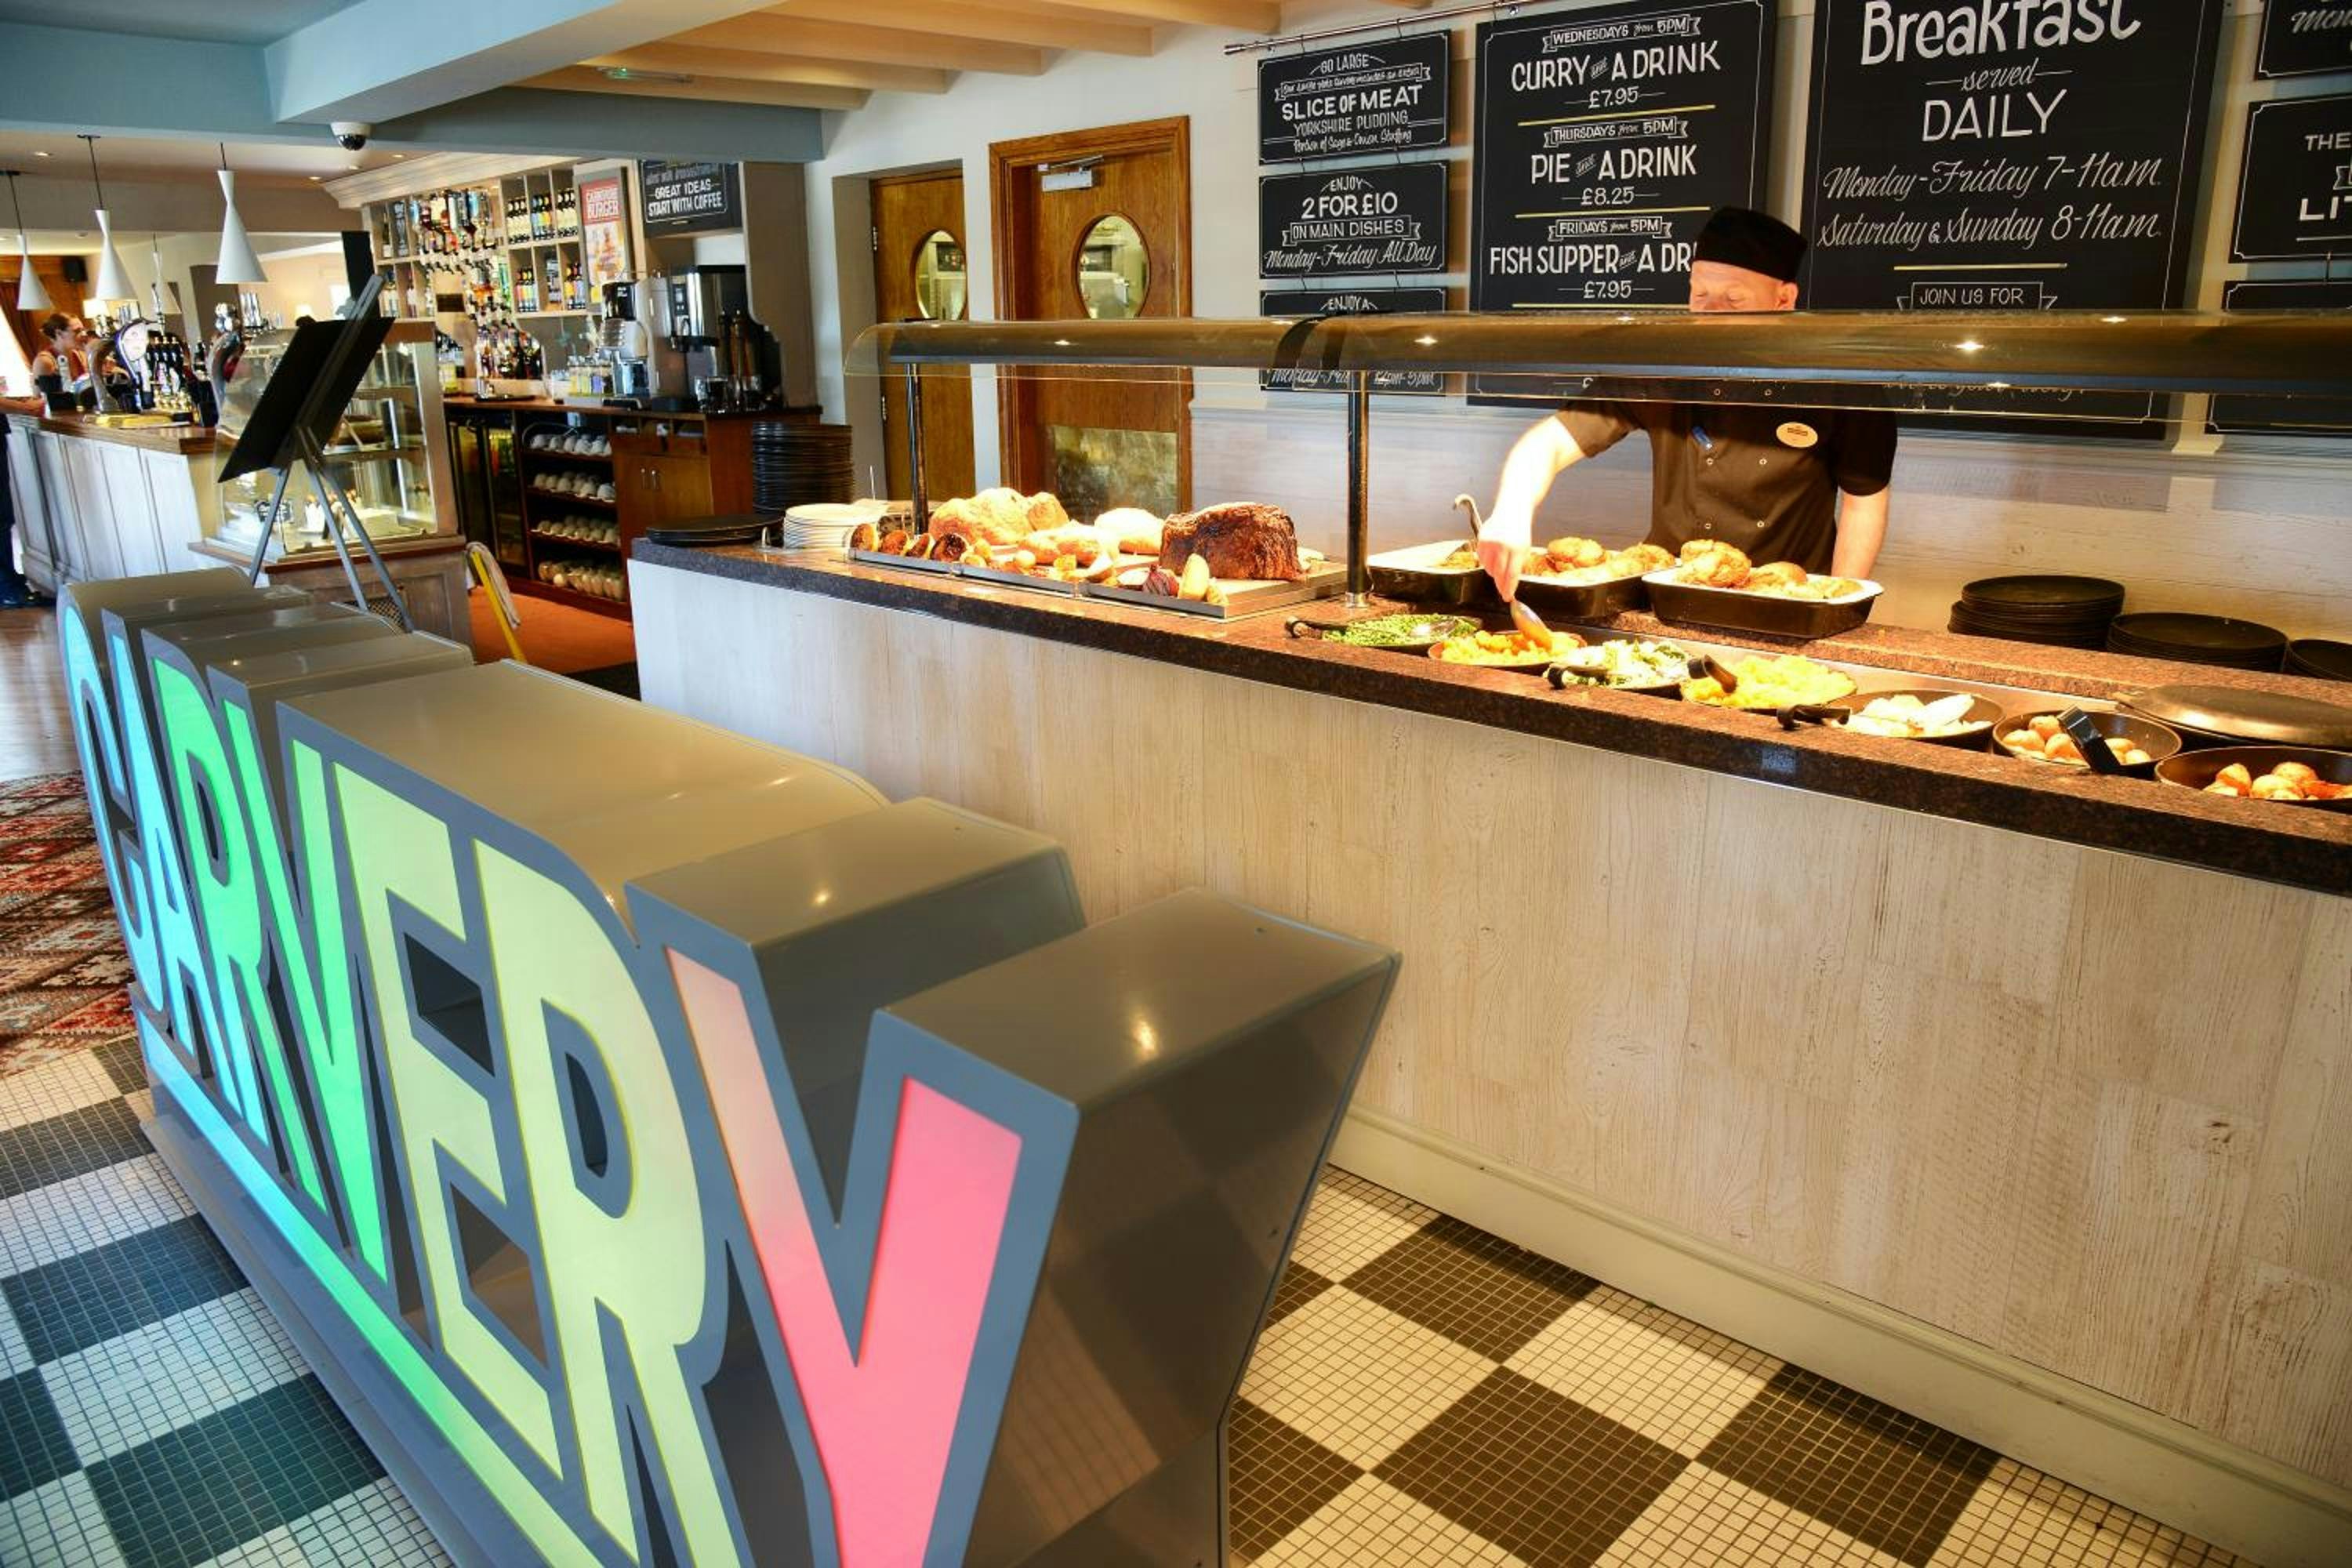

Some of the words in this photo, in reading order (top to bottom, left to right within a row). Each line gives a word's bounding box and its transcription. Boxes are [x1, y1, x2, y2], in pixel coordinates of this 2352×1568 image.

[1552, 25, 1628, 45] WEDNESDAYS
[1657, 17, 1687, 34] 5PM
[1320, 60, 1334, 74] GO
[1337, 53, 1370, 71] LARGE
[1512, 54, 1592, 91] CURRY
[1611, 52, 1628, 81] A
[1633, 41, 1722, 78] DRINK
[1962, 57, 2039, 91] served
[1282, 97, 1336, 122] SLICE
[1339, 94, 1357, 114] OF
[1360, 84, 1423, 110] MEAT
[1588, 85, 1639, 109] £7.95
[1294, 117, 1352, 137] YORKSHIRE
[1356, 110, 1408, 130] PUDDING
[1922, 89, 2067, 142] DAILY
[1328, 136, 1345, 151] Sage
[1354, 132, 1378, 145] Onion
[1381, 128, 1412, 144] Stuffing
[1554, 125, 1616, 142] THURSDAYS
[1642, 119, 1675, 135] 5PM
[2304, 132, 2352, 151] THE
[1531, 153, 1570, 184] PIE
[1598, 151, 1616, 180] A
[1621, 144, 1697, 179] DRINK
[655, 184, 681, 199] GREAT
[684, 179, 711, 195] IDEAS
[1330, 176, 1363, 192] ENJOY
[1581, 187, 1635, 205] £8.25
[588, 200, 619, 218] BURGER
[648, 201, 670, 216] START
[670, 196, 692, 213] WITH
[694, 191, 722, 209] COFFEE
[1301, 198, 1316, 220] 2
[1319, 194, 1358, 218] FOR
[1362, 192, 1399, 216] £10
[2299, 195, 2352, 221] LI
[1293, 225, 1308, 240] ON
[1308, 222, 1345, 239] MAIN
[1349, 219, 1404, 236] DISHES
[1559, 221, 1608, 235] FRIDAYS
[1630, 219, 1659, 233] 5PM
[1817, 209, 1929, 252] Saturday
[1928, 222, 1943, 245] &
[1946, 207, 2043, 250] Sunday
[1378, 240, 1404, 264] All
[1403, 241, 1437, 267] Day
[1490, 246, 1532, 275] FISH
[1536, 245, 1620, 274] SUPPER
[1637, 244, 1655, 273] A
[1584, 281, 1632, 299] £7.95
[1919, 289, 1957, 306] JOIN
[1962, 289, 1984, 305] US
[1991, 288, 2024, 305] FOR
[1329, 296, 1361, 310] ENJOY
[1362, 298, 1370, 310] A
[61, 596, 1022, 1568] CARVERY
